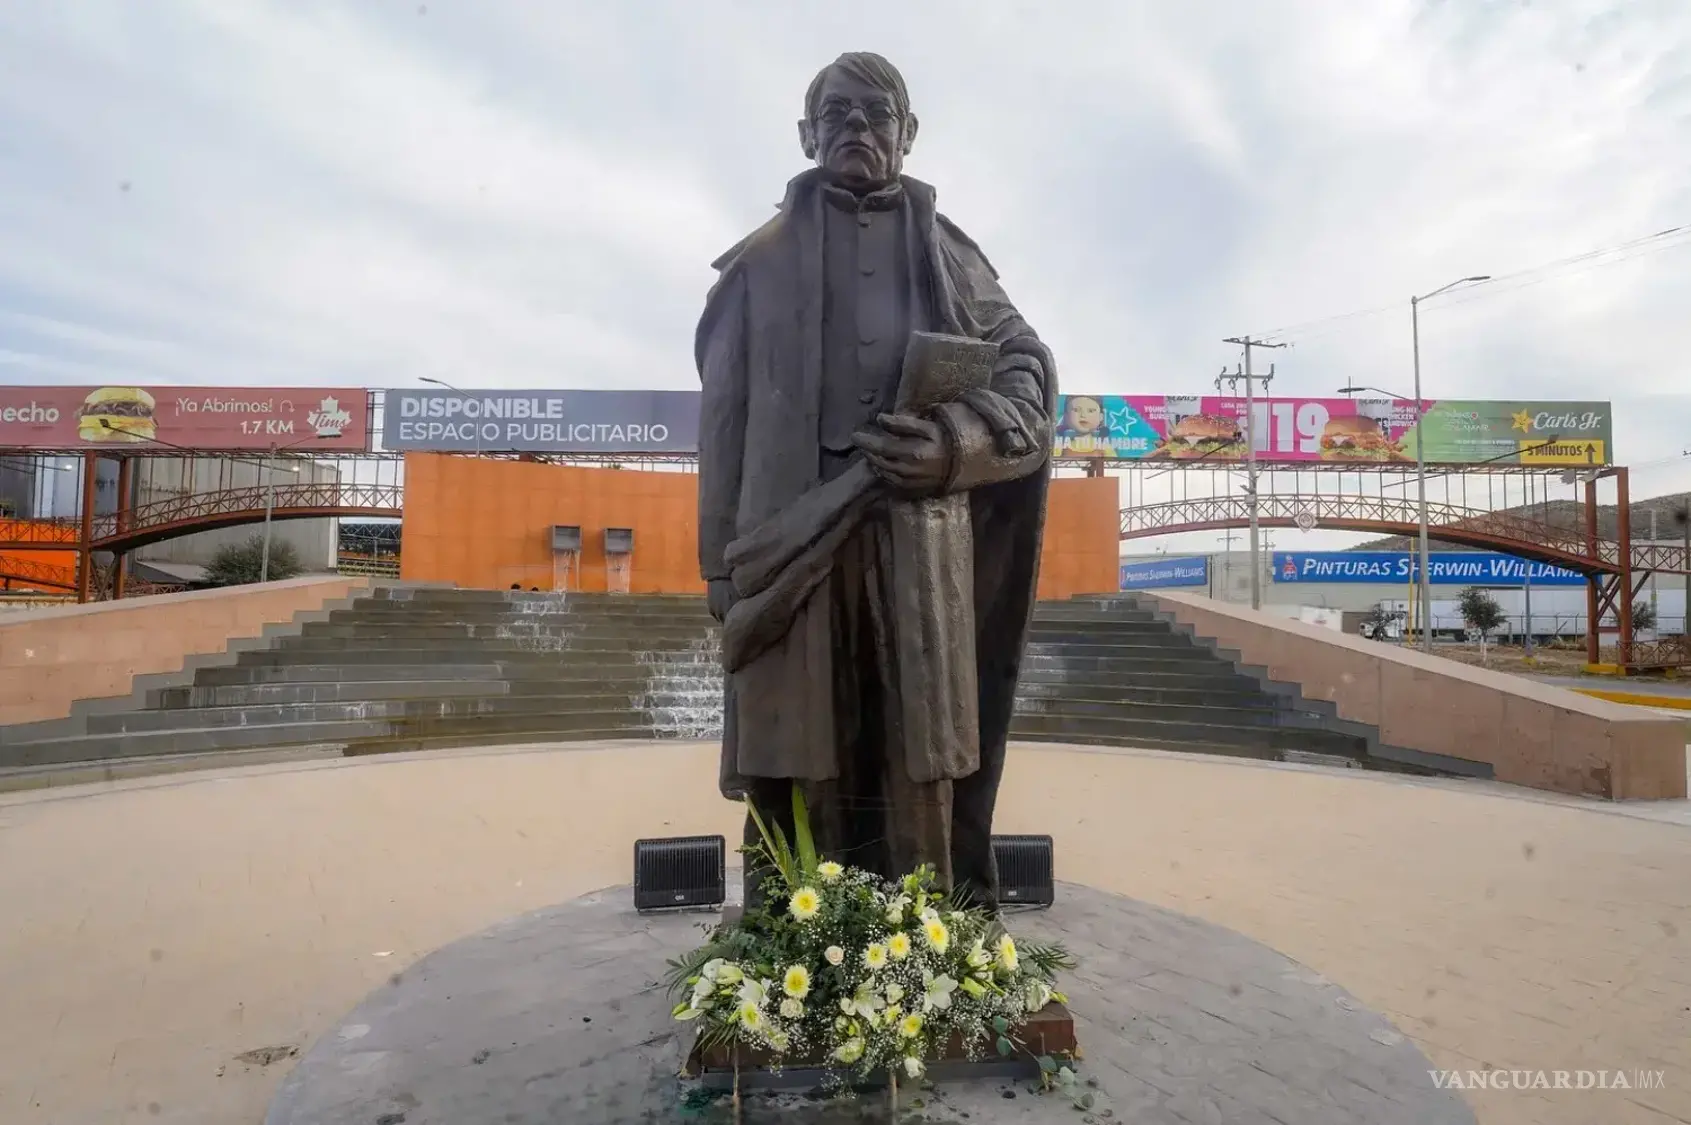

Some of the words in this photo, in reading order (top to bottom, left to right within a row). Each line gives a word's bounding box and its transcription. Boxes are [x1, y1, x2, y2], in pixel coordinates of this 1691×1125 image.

[0, 400, 60, 423] echo
[175, 398, 198, 416] ¡Ya
[201, 398, 273, 414] Abrimos!
[400, 396, 564, 419] DISPONIBLE
[240, 420, 262, 435] 1.7
[266, 420, 294, 435] KM
[1533, 411, 1577, 430] Carl's
[1579, 411, 1602, 431] Jr.
[399, 422, 500, 442] ESPACIO
[506, 423, 669, 443] PUBLICITARIO
[1535, 444, 1583, 456] MINUTOS
[1302, 558, 1391, 576] PINTURAS
